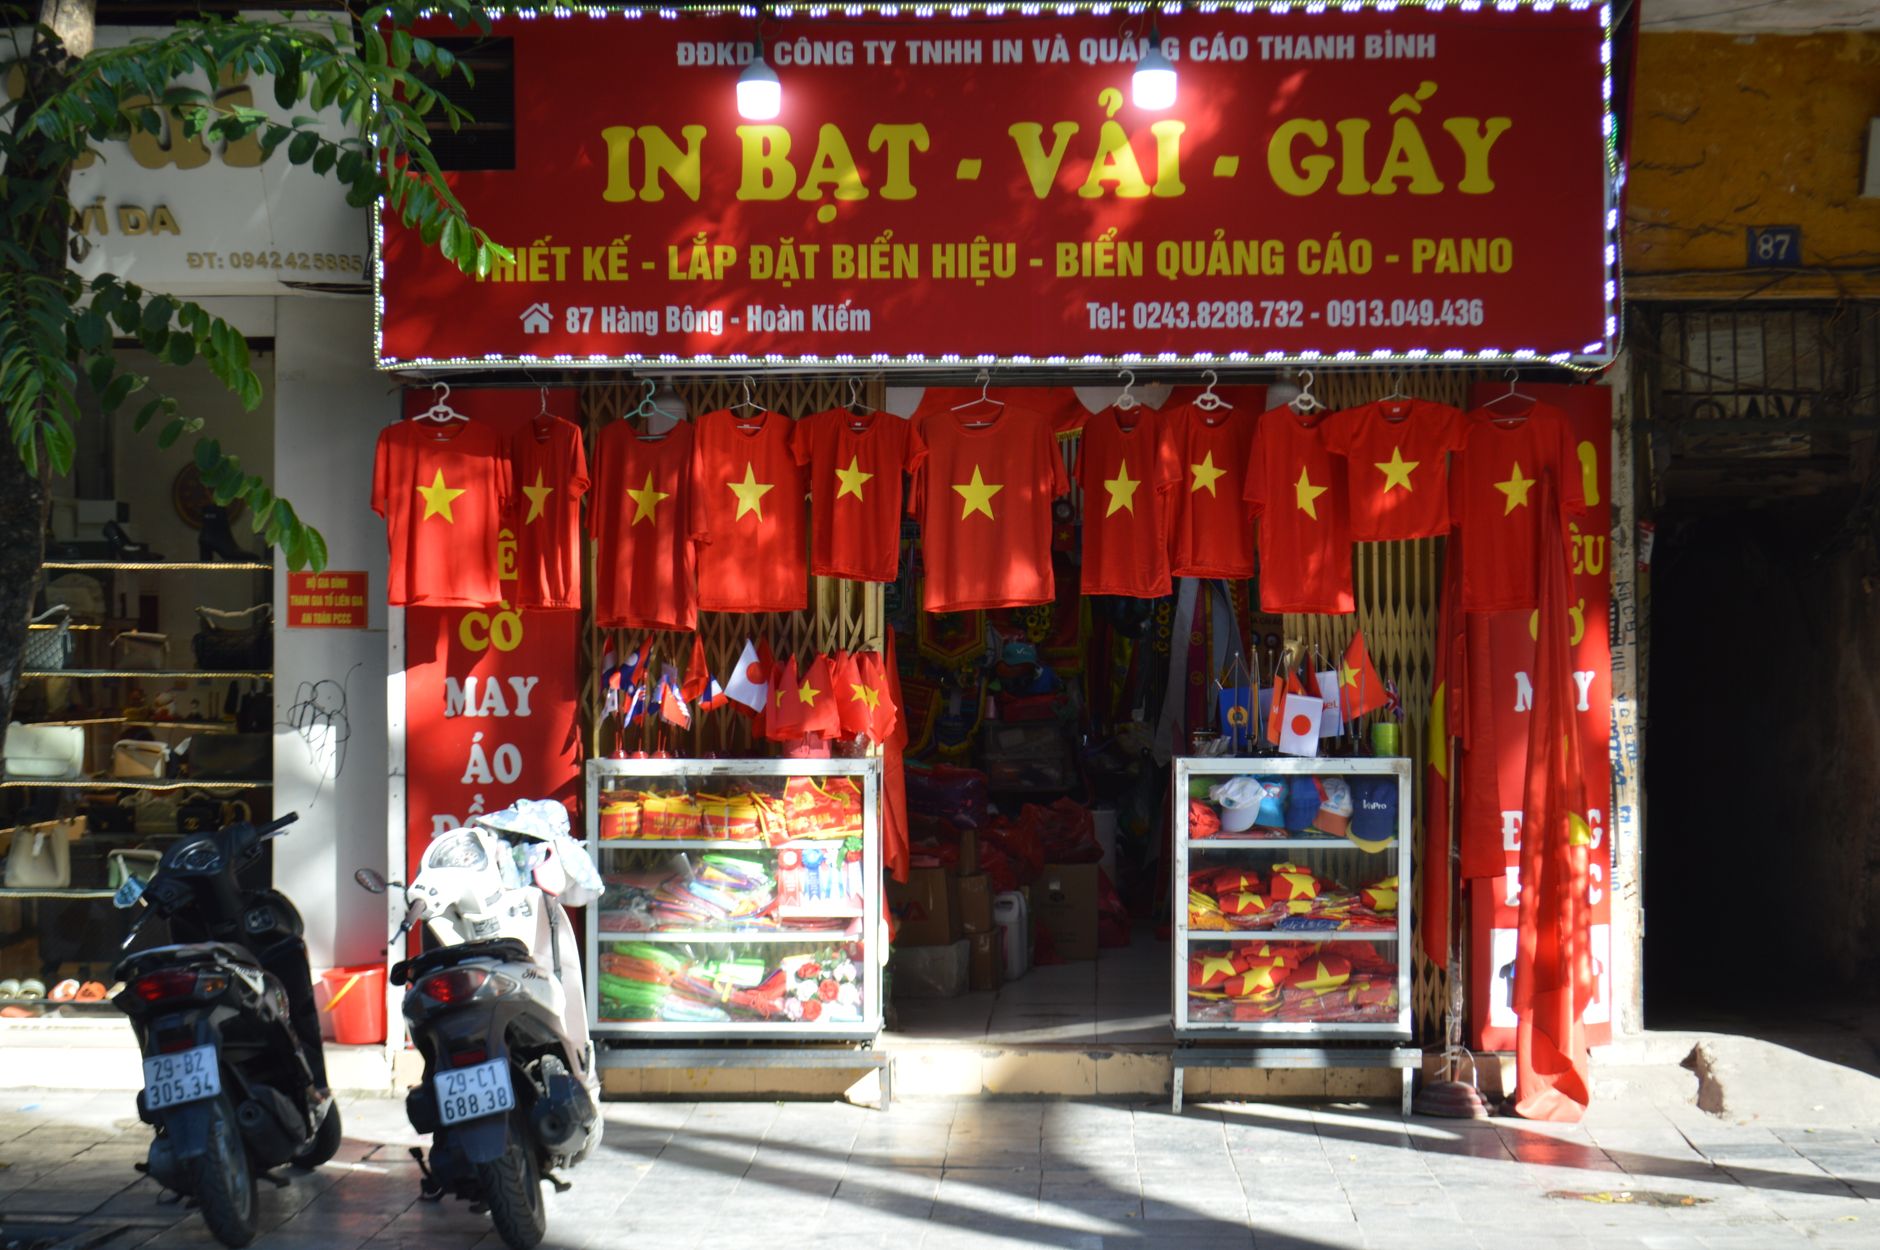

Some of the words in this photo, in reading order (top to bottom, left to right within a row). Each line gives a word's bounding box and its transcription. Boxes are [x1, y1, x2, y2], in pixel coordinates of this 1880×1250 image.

[774, 36, 854, 66] CÔNG
[862, 40, 896, 65] TY
[905, 39, 983, 65] TNHH
[992, 39, 1023, 64] IN
[1032, 33, 1070, 64] VÀ
[1189, 31, 1249, 62] CÁO
[1257, 35, 1355, 61] THANH
[1364, 30, 1436, 59] BÌNH
[601, 124, 708, 203] IN
[735, 122, 930, 224] BẠT
[1008, 86, 1186, 199] VẢI
[1267, 80, 1512, 197] GIẤY
[118, 203, 182, 236] DA
[582, 234, 630, 281] KẾ
[668, 231, 737, 281] LẮP
[748, 237, 819, 288] ĐẶT
[832, 229, 919, 279] BIỂN
[932, 235, 1017, 287] HIỆU
[1056, 226, 1144, 278] BIỂN
[1156, 228, 1285, 281] QUẢNG
[1297, 231, 1373, 276] CÁO
[1412, 237, 1513, 273] PANO
[1757, 233, 1791, 261] 87
[565, 306, 594, 334] 87
[601, 305, 659, 337] Hàng
[665, 304, 724, 336] Bông
[746, 303, 805, 333] Hoàn
[811, 299, 871, 332] Kiếm
[1086, 301, 1126, 330] Tel:
[1132, 299, 1304, 330] 0243.8288.732
[1326, 298, 1484, 327] 0913.049.436
[459, 600, 523, 651] CỜ
[444, 676, 539, 717] MAY
[461, 731, 523, 785] ÁO
[150, 1071, 213, 1106] 305.34
[446, 1064, 497, 1096] 29-C1
[444, 1087, 508, 1120] 688.38
